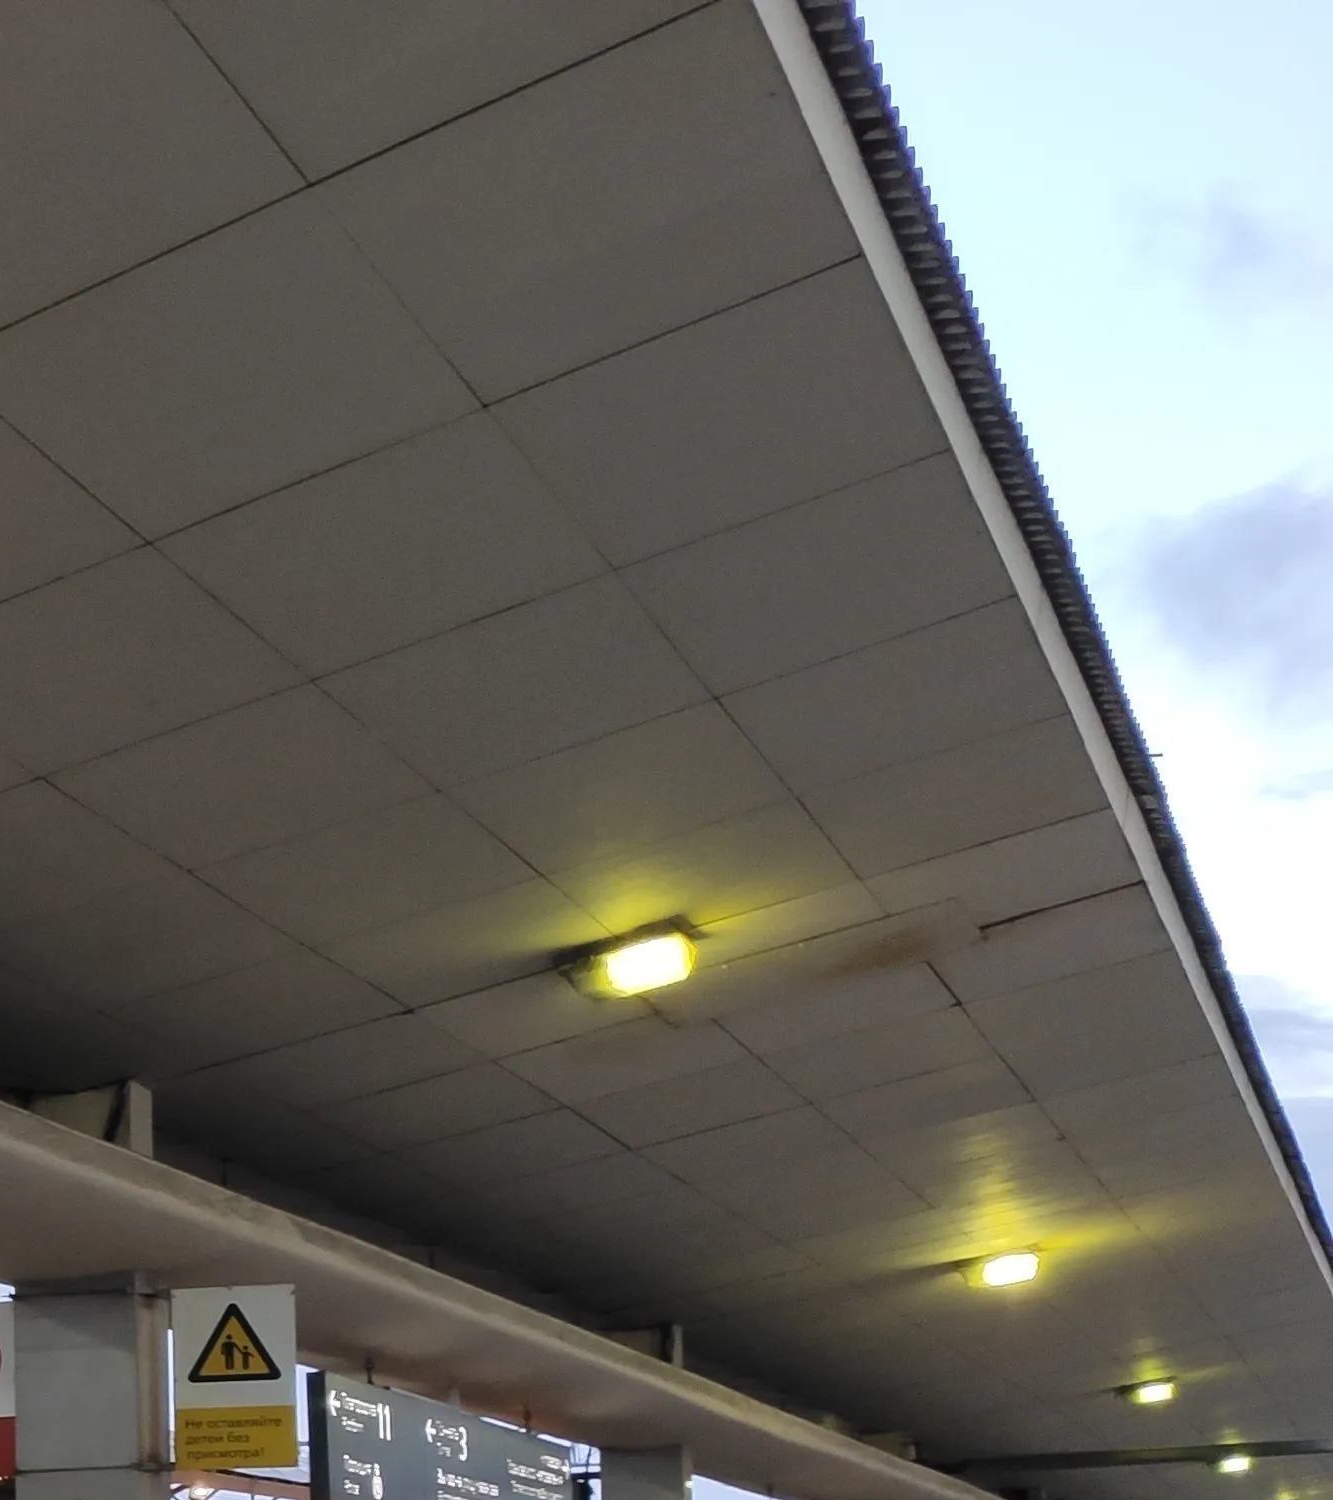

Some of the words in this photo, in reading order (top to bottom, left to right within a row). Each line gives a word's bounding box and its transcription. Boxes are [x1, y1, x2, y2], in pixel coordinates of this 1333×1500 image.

[185, 1419, 203, 1429] Не
[205, 1415, 282, 1429] оставляйте
[227, 1431, 250, 1443] без
